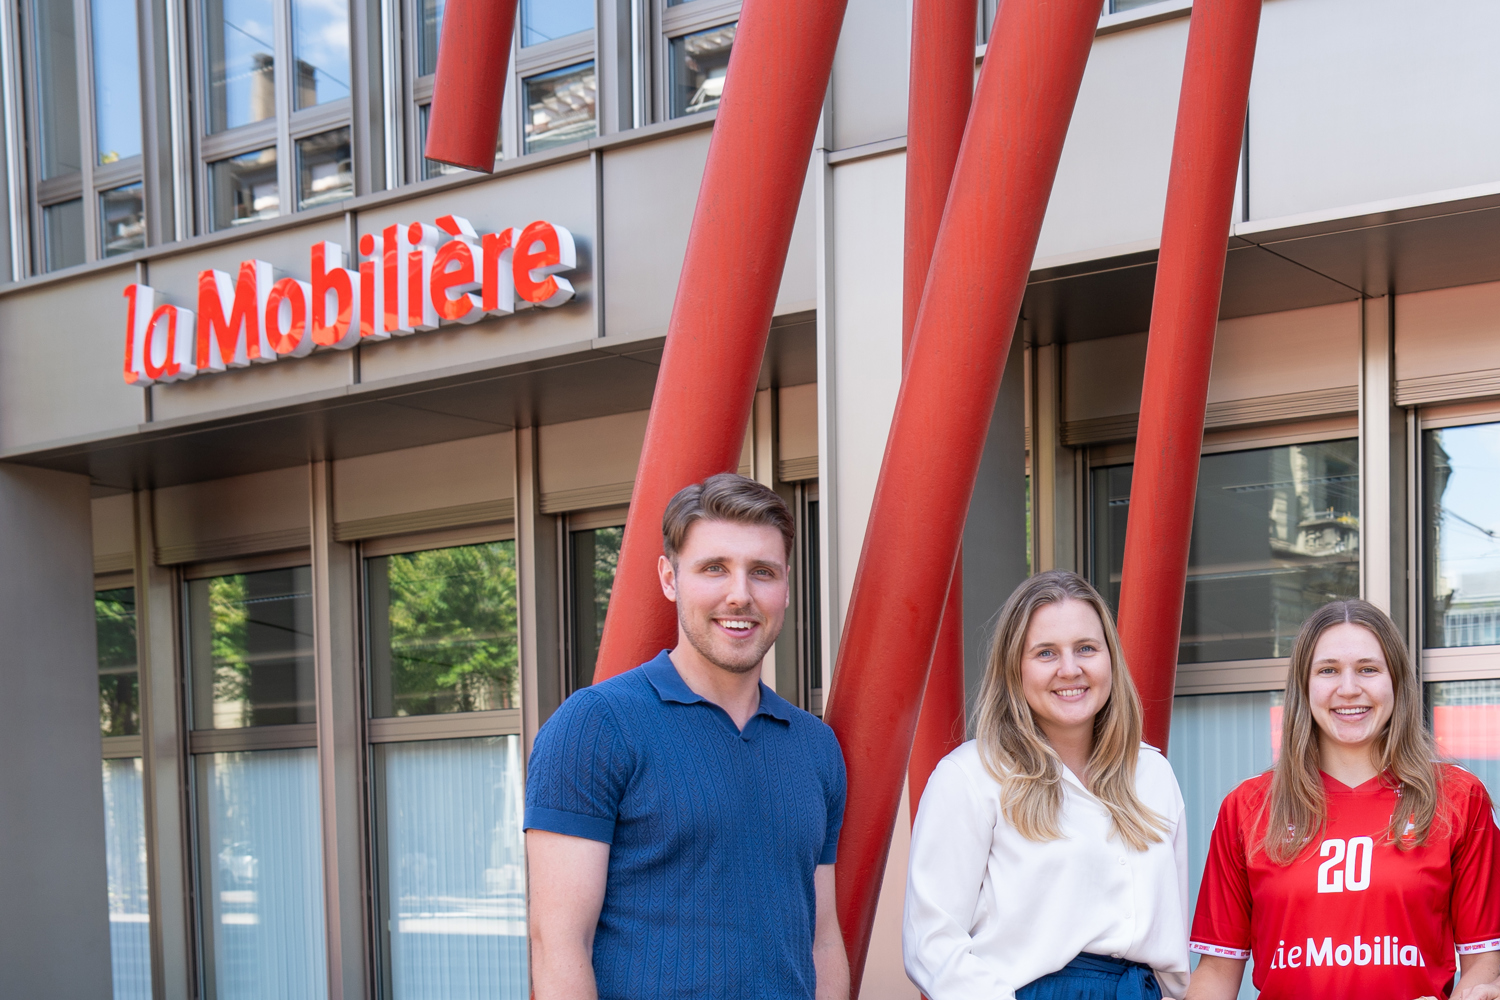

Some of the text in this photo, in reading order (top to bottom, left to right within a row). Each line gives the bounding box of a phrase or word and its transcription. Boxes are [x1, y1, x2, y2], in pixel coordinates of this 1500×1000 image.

[123, 214, 577, 387] la Mobilière
[1317, 836, 1373, 893] 20
